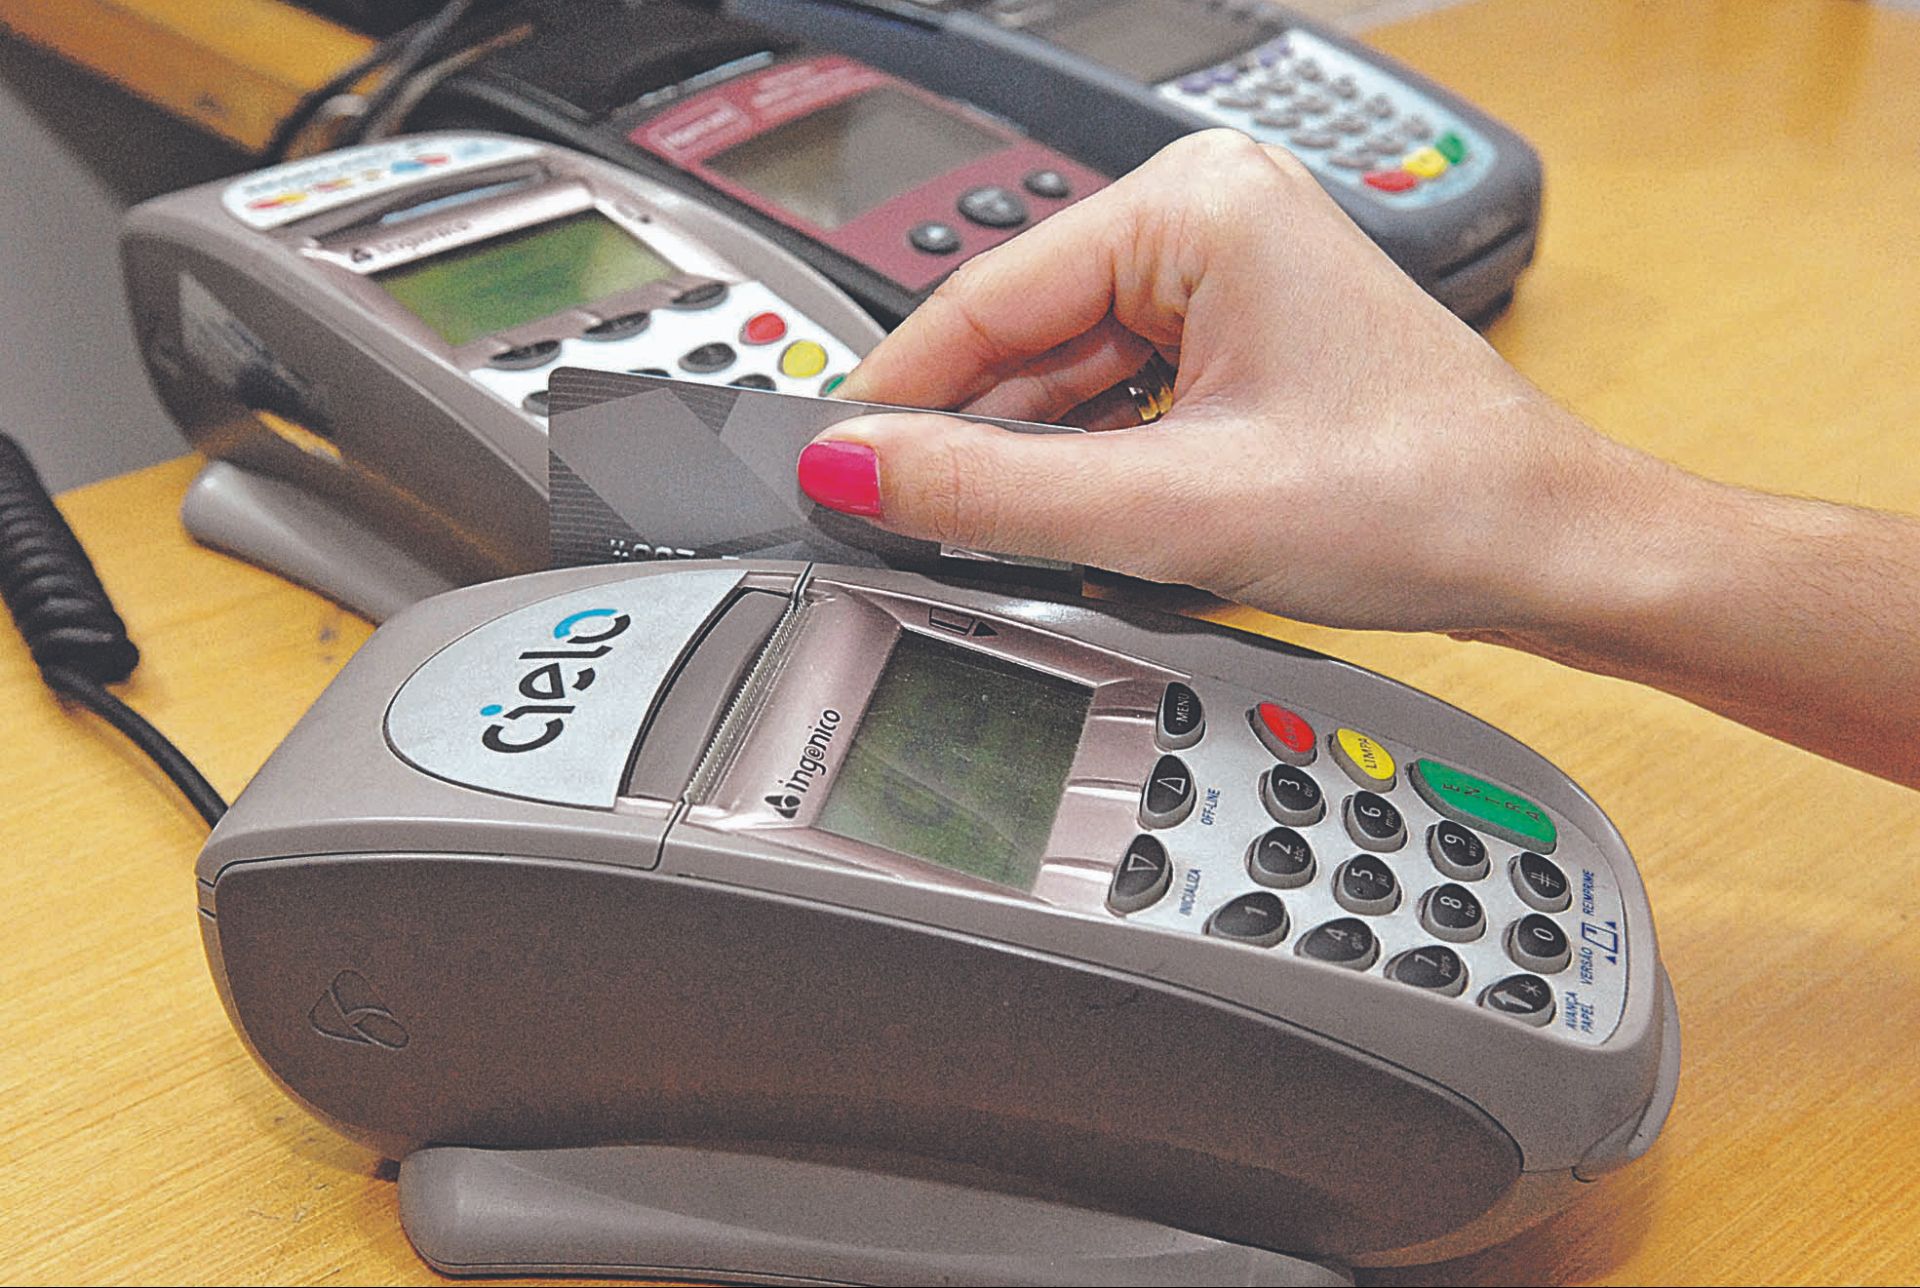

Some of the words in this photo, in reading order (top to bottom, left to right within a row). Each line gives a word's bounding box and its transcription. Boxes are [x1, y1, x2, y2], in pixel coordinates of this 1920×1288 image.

[479, 608, 631, 753] cielo
[1176, 692, 1190, 723] MENU
[1358, 737, 1378, 770] LIMPA
[1278, 778, 1301, 791] 3
[1200, 787, 1221, 826] OFF-LINE
[1360, 805, 1382, 817] 6
[1268, 841, 1292, 855] 2
[1444, 834, 1466, 846] 9
[1294, 846, 1305, 863] abc
[1351, 867, 1373, 881] 5
[1582, 868, 1595, 917] REIMPRIME
[1439, 895, 1463, 910] 8
[1243, 905, 1268, 917] 1
[1325, 927, 1349, 942] 4
[1532, 927, 1554, 942] 0
[1414, 952, 1439, 968] 7
[1579, 946, 1594, 986] VERSÃO
[1565, 990, 1580, 1030] AVANÇA
[1580, 1002, 1595, 1035] PAPEL
